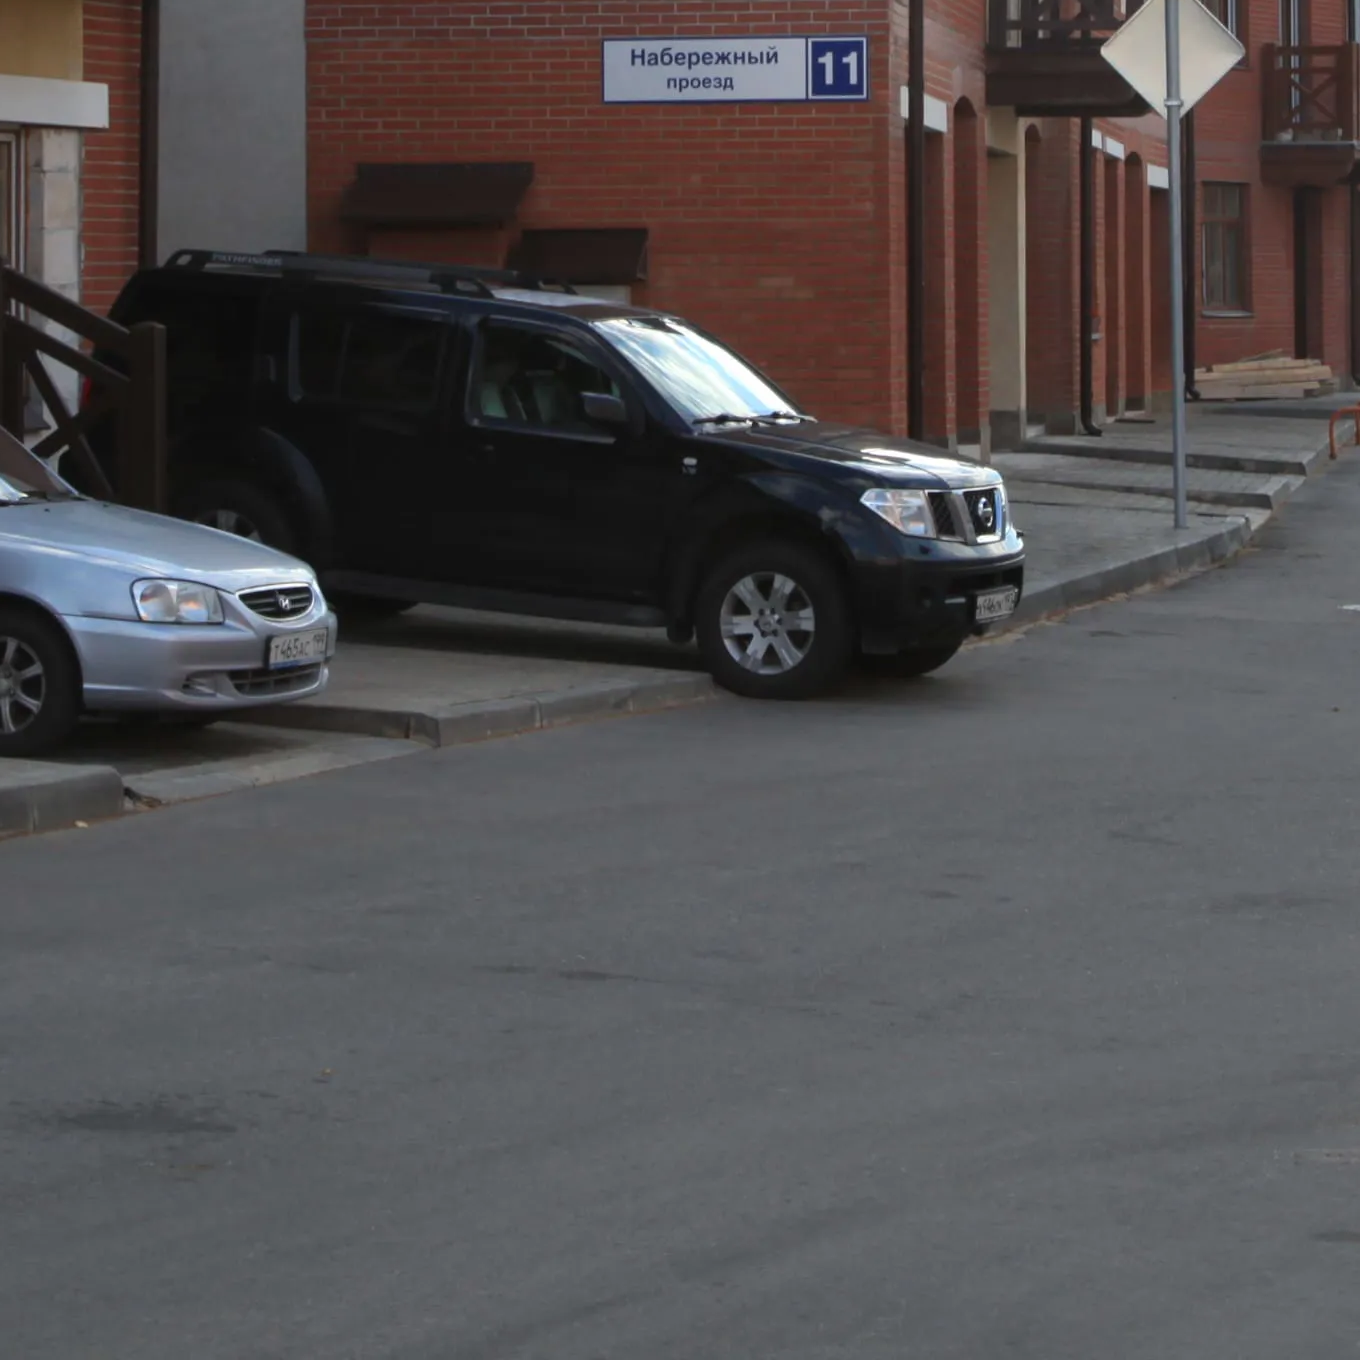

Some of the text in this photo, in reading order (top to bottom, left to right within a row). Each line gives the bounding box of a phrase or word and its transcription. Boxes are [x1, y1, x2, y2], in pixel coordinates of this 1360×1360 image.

[630, 46, 779, 71] Набережный
[817, 50, 859, 86] 11
[666, 76, 735, 93] проезд
